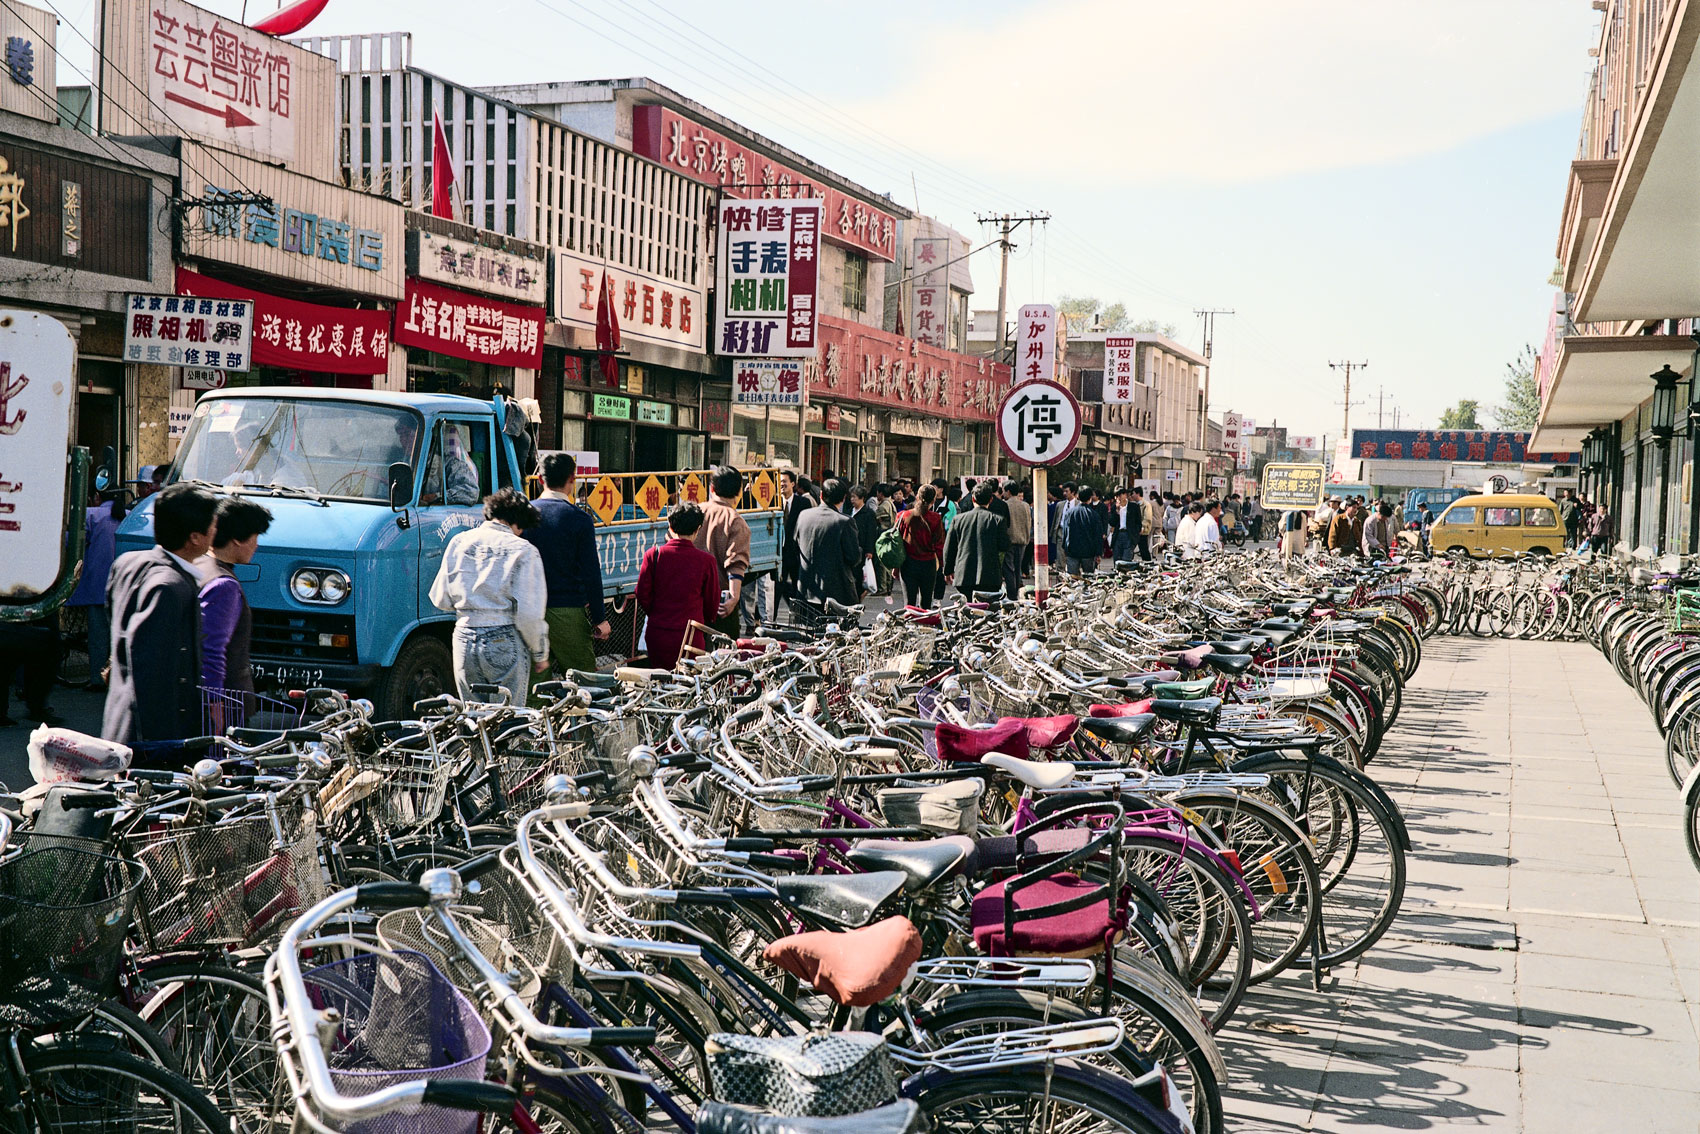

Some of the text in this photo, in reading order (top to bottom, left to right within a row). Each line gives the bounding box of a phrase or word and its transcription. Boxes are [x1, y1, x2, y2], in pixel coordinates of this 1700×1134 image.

[153, 9, 291, 119] 芸芸粤菜馆
[668, 120, 748, 195] 北京烤鸭
[722, 206, 786, 232] 快修
[793, 212, 815, 262] 王府井
[838, 200, 895, 254] 各种饮料
[731, 240, 788, 274] 手表
[131, 295, 247, 318] 北京照相器材部
[578, 267, 692, 335] 王井百貨店
[730, 278, 787, 312] 相机
[1024, 310, 1051, 319] U.S.A.
[131, 313, 208, 343] 照相机
[252, 313, 389, 360] 游鞋优惠展销
[403, 292, 467, 344] 上海名牌
[501, 315, 539, 356] 展销
[722, 321, 779, 354] 彩扩
[790, 294, 813, 342] 百货店
[737, 368, 801, 394] 快修
[1116, 349, 1131, 400] 皮货服装
[1012, 394, 1062, 455] 停
[1223, 441, 1239, 450] WC
